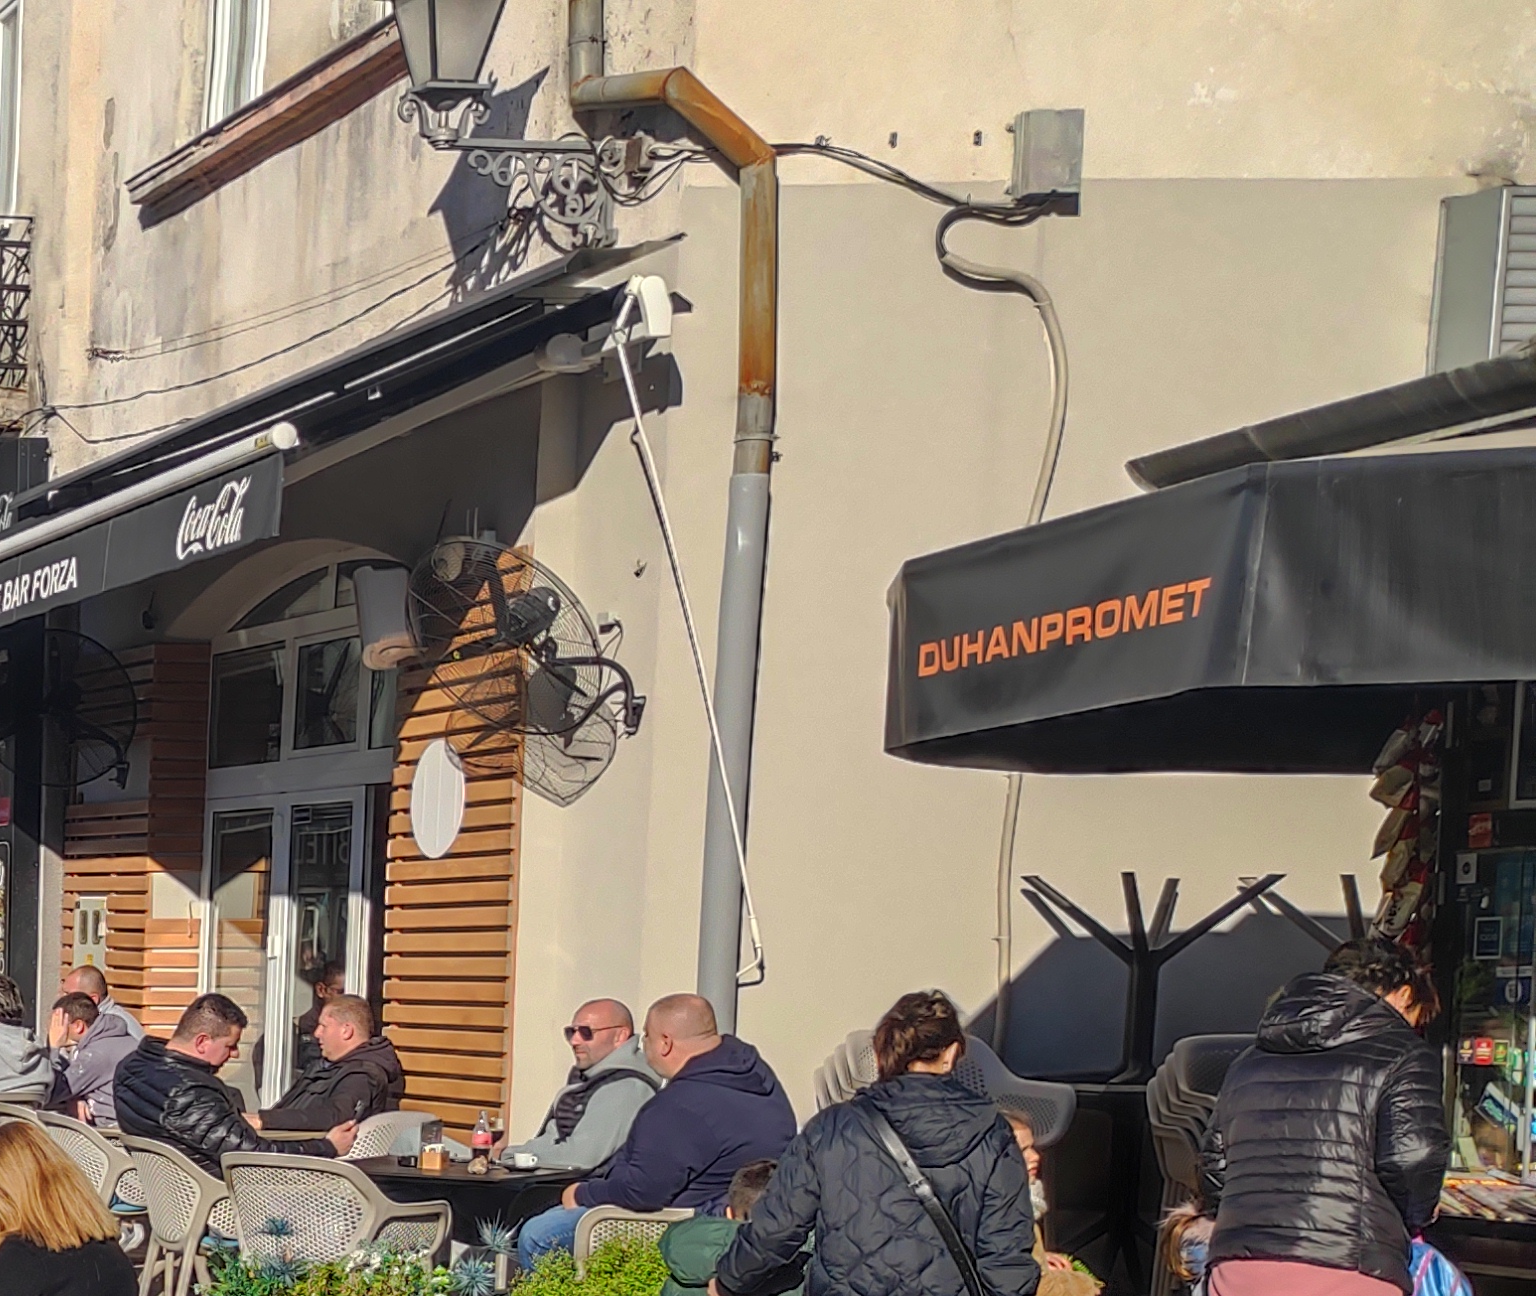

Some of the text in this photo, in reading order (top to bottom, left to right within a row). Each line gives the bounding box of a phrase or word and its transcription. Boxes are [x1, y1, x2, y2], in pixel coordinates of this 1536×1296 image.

[2, 573, 28, 612] BAR
[30, 556, 77, 602] FORZA
[918, 577, 1212, 677] DUHANPROMET
